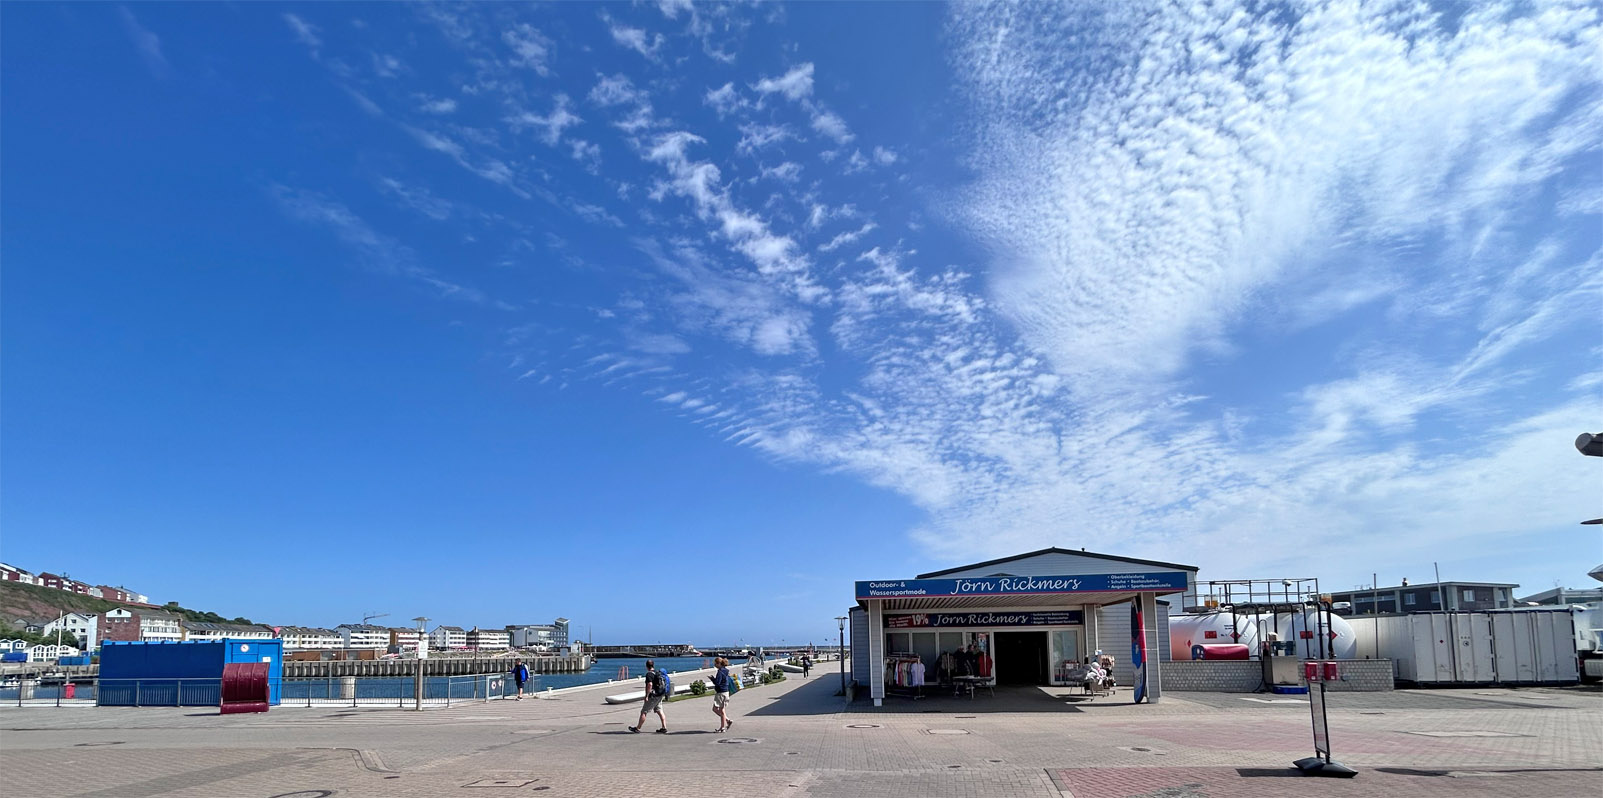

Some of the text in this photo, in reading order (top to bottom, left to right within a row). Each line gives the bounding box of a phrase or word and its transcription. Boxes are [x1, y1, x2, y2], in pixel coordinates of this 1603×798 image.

[869, 588, 927, 596] Wassersportmode
[950, 576, 1081, 595] Jörn Rickmers
[911, 613, 929, 626] 19%
[933, 612, 1028, 627] Jörn Rickmers
